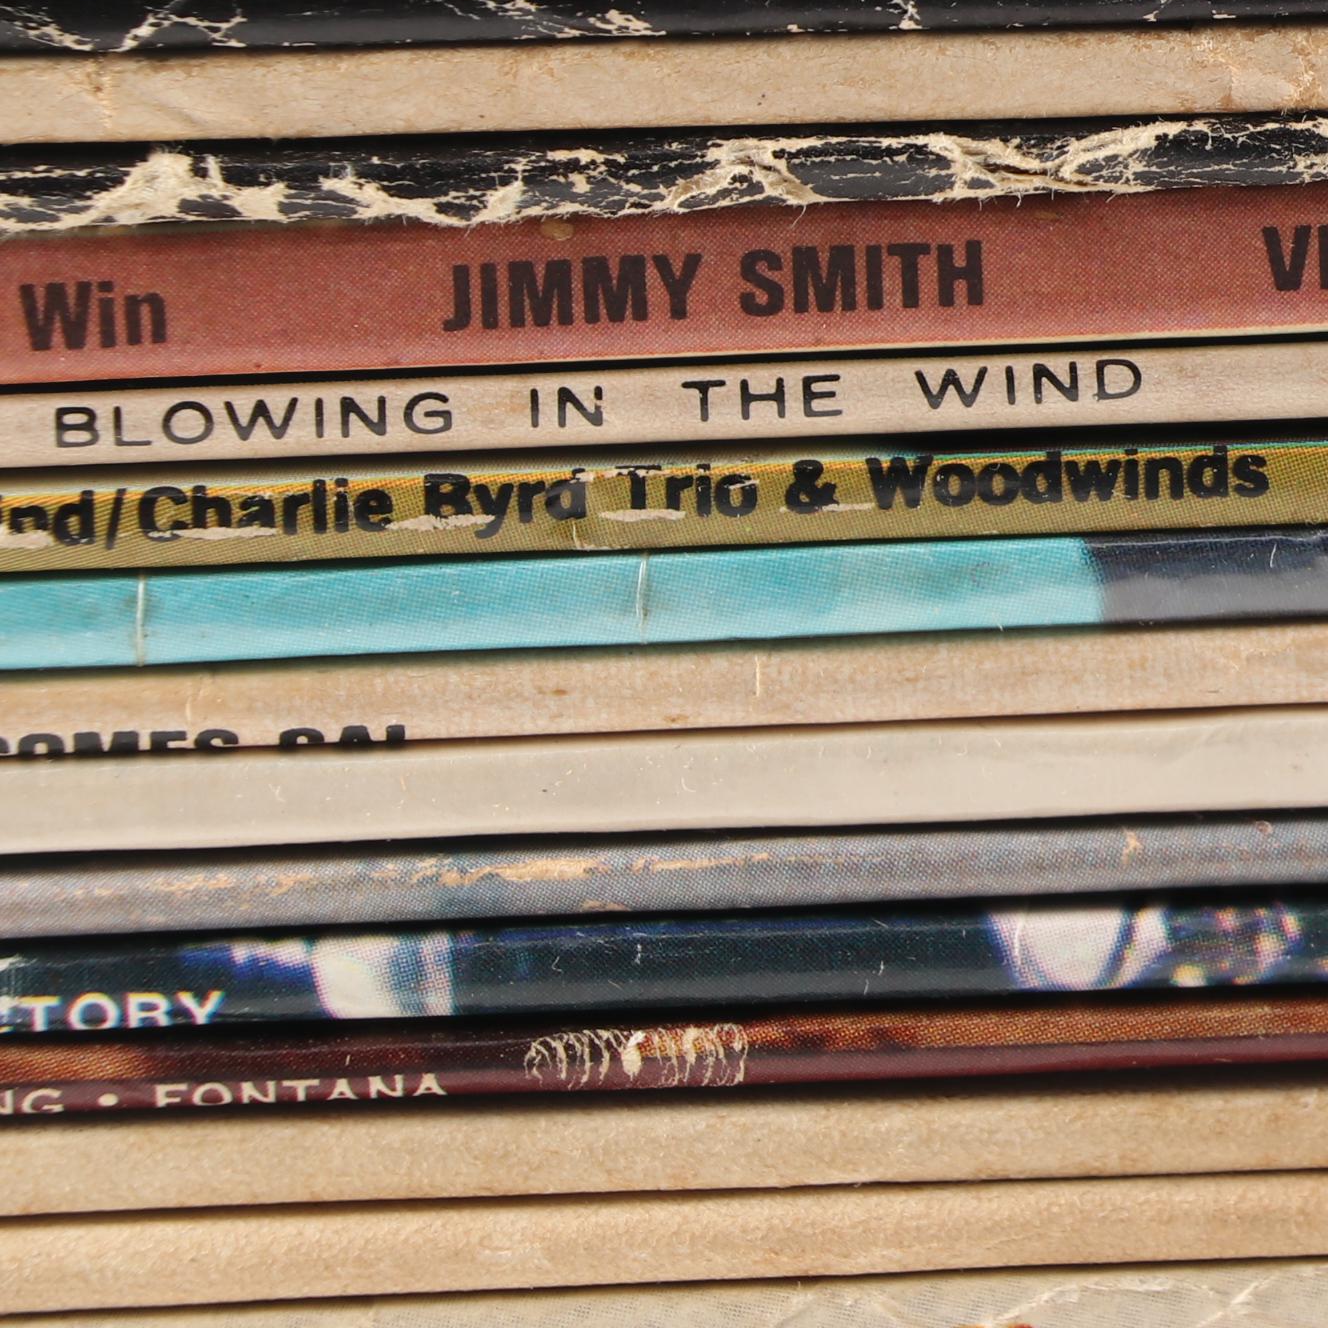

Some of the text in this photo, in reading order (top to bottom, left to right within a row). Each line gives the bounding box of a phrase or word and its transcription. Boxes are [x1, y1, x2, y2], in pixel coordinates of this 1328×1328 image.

[19, 280, 169, 352] Win
[442, 251, 703, 333] JIMMY
[738, 239, 985, 318] SMITH
[54, 358, 1143, 449] BLOWING IN THE WIND
[0, 444, 1270, 550] nd/Charlie Byrd Trio & Woodwinds
[153, 1072, 448, 1109] FONTANA
